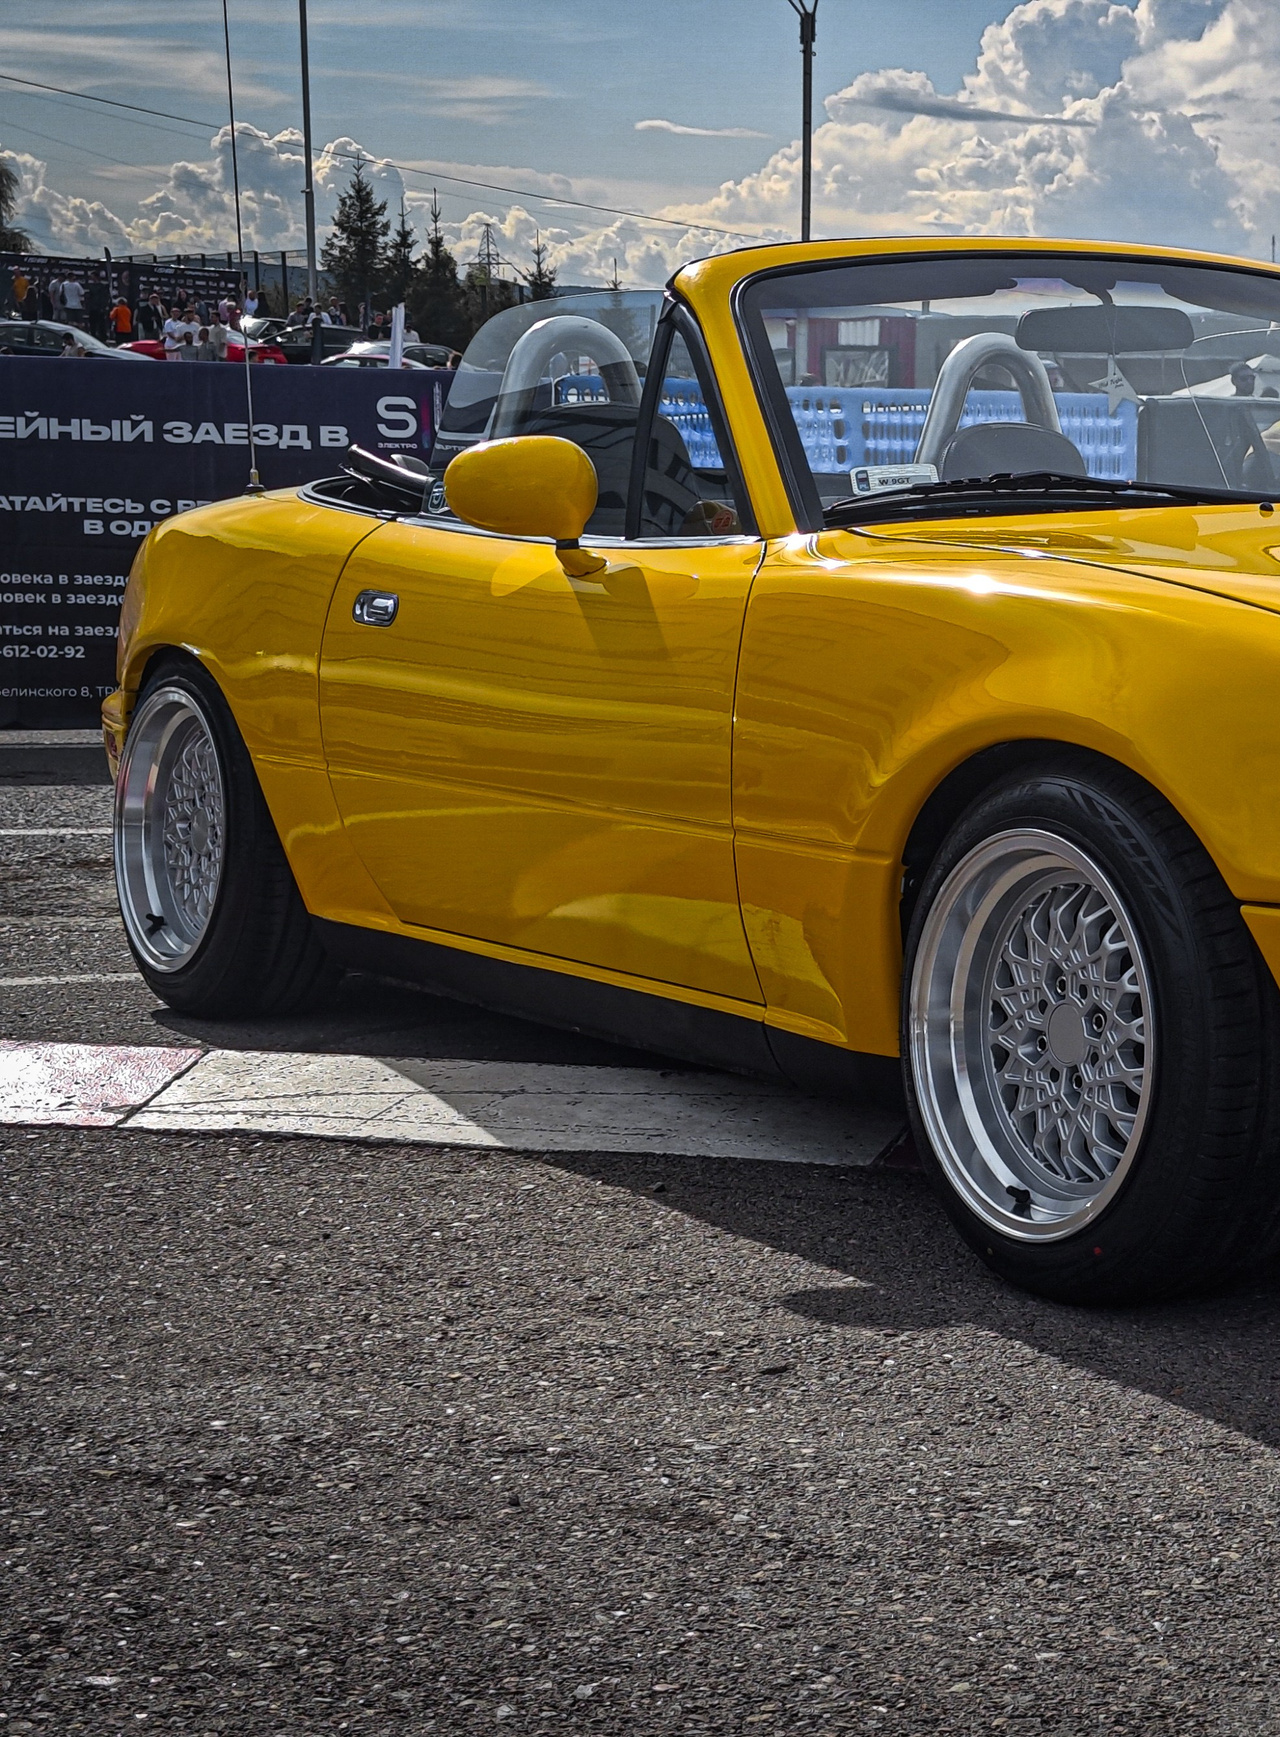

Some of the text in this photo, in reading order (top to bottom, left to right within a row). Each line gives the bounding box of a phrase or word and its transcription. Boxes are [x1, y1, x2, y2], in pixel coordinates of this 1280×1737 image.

[162, 421, 312, 450] ЗАЕЗД
[319, 425, 349, 447] В
[150, 499, 172, 515] С
[83, 519, 159, 538] В ОД
[58, 574, 69, 585] в
[73, 575, 129, 587] заезд
[0, 592, 46, 604] овек
[51, 594, 62, 604] в
[0, 625, 43, 636] ться
[48, 625, 70, 636] на
[0, 687, 78, 698] елинского
